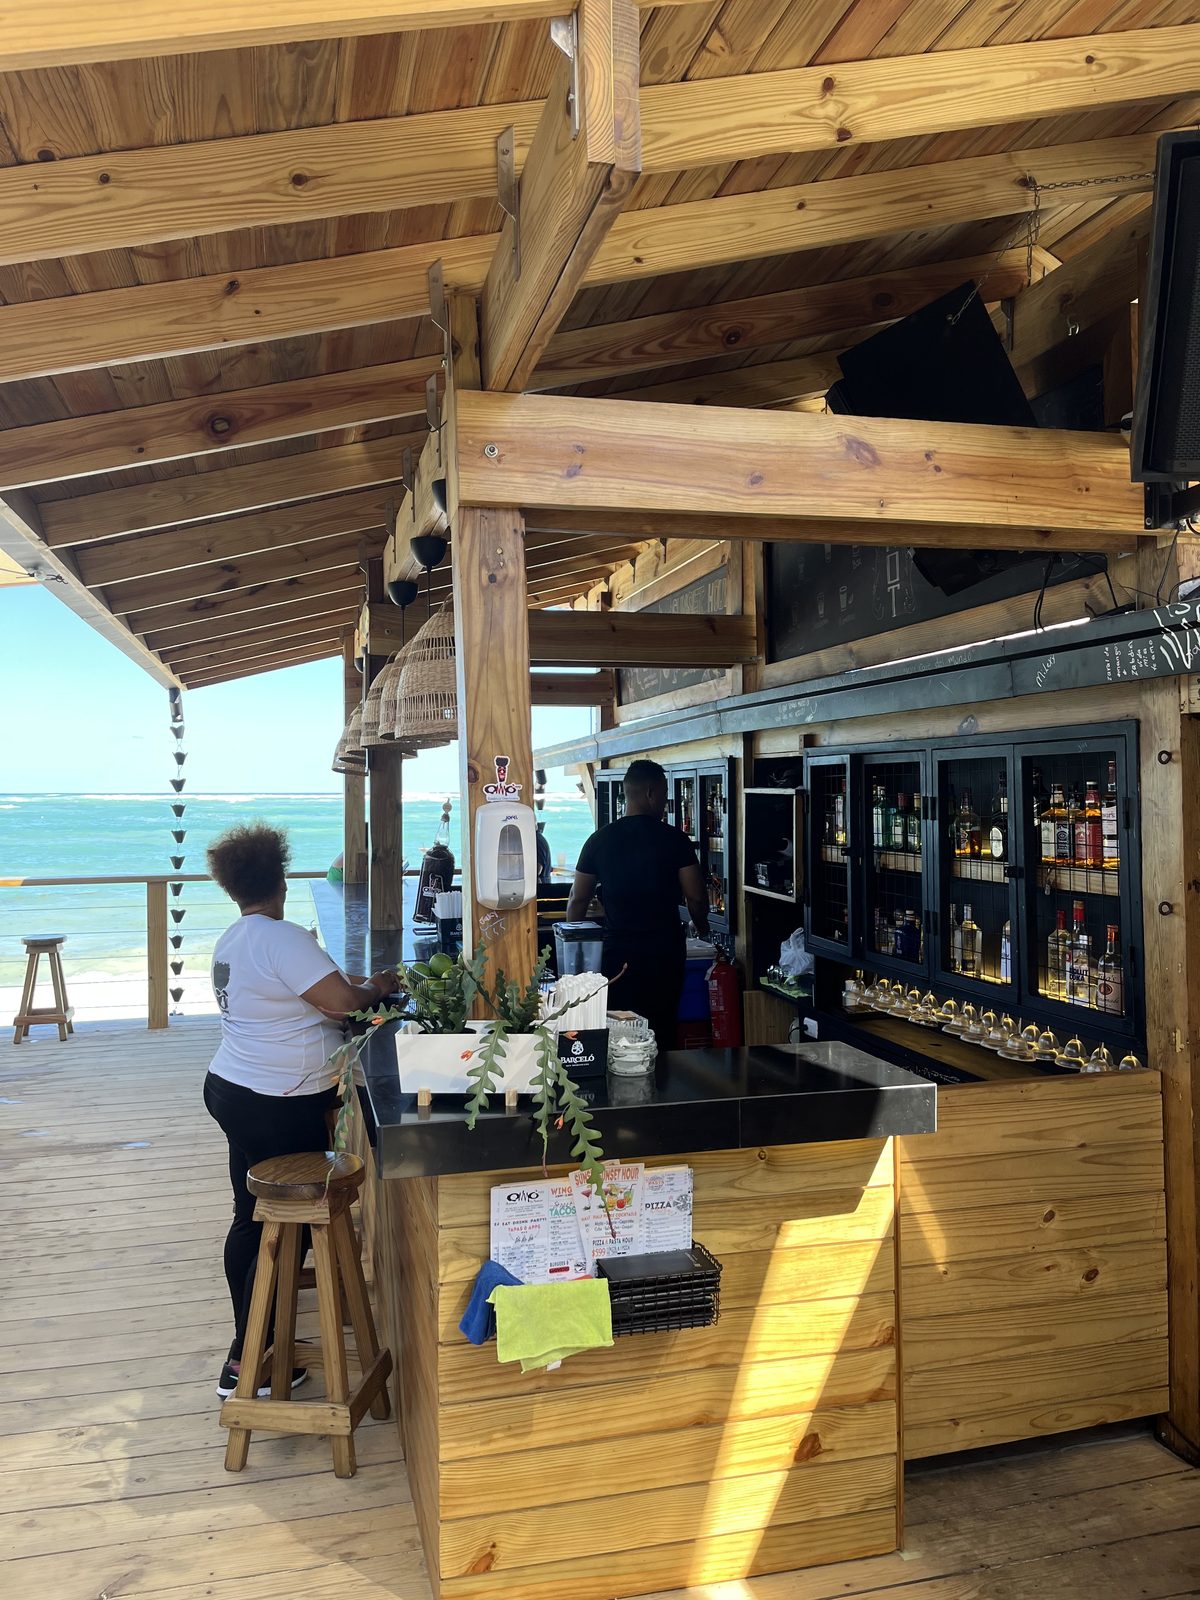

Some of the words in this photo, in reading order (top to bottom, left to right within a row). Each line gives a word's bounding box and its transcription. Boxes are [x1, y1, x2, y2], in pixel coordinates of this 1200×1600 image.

[560, 1053, 595, 1064] BARCELÓ
[621, 1167, 640, 1180] HOUR
[644, 1201, 672, 1210] PIZZA
[549, 1206, 577, 1216] TACOS
